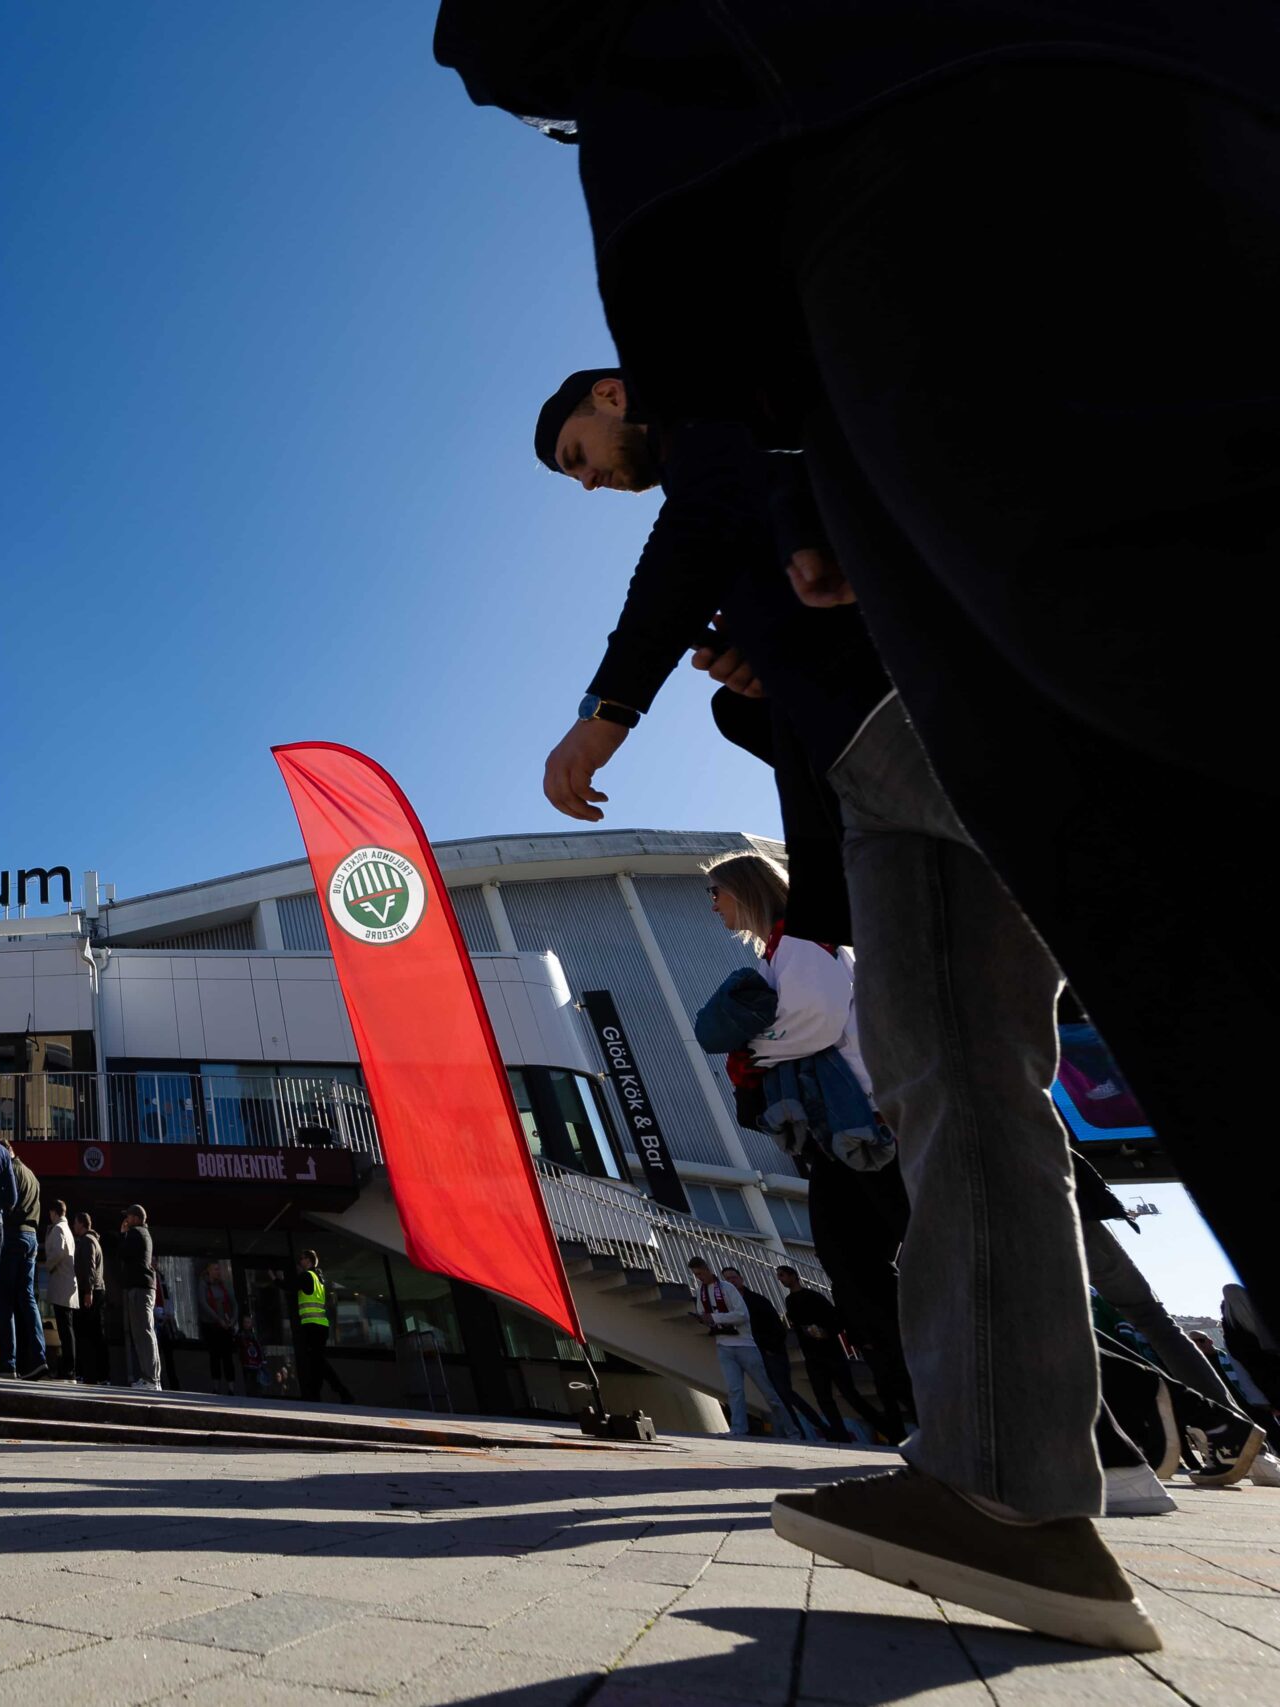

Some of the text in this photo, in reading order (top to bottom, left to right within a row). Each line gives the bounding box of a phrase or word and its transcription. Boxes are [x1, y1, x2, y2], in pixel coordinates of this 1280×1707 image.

[602, 1026, 665, 1171] Glöd Kök & Bar
[196, 1150, 287, 1179] BORTAENTRÉ
